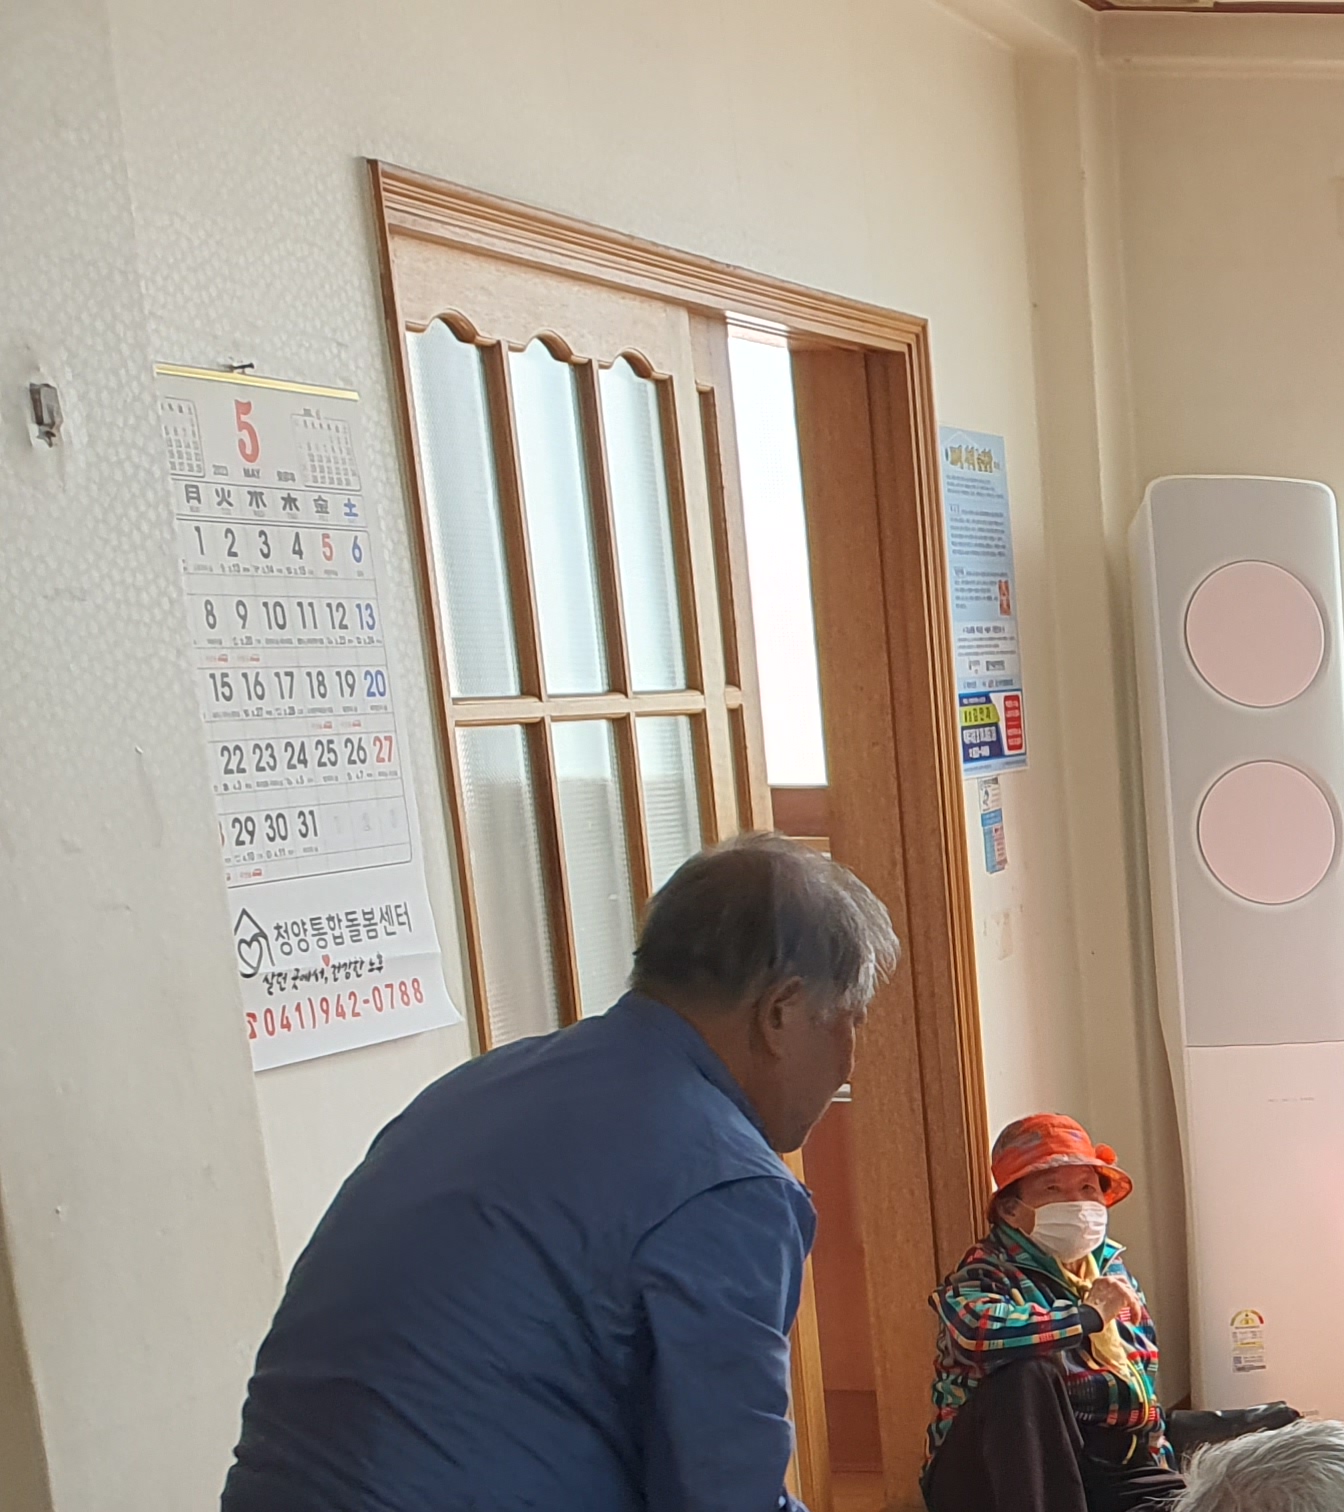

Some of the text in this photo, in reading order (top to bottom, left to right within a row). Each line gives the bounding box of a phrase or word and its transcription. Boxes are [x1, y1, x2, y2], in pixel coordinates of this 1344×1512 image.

[234, 399, 260, 463] 5
[243, 468, 260, 479] MAY
[215, 487, 234, 508] 火
[281, 493, 300, 512] 木
[313, 495, 330, 514] 金
[344, 498, 358, 517] 土
[194, 526, 362, 563] 1 2 3 4 5 6
[204, 599, 376, 630] 8 9 10 11 12 13
[209, 670, 386, 702] 15 16 17 18 19 20
[220, 735, 393, 775] 22 23 24 25 26 27
[232, 810, 318, 846] 29 30 31
[273, 901, 412, 956] 청양통합돌봄센터
[262, 971, 288, 995] 살던
[263, 978, 424, 1036] 041)942-0788
